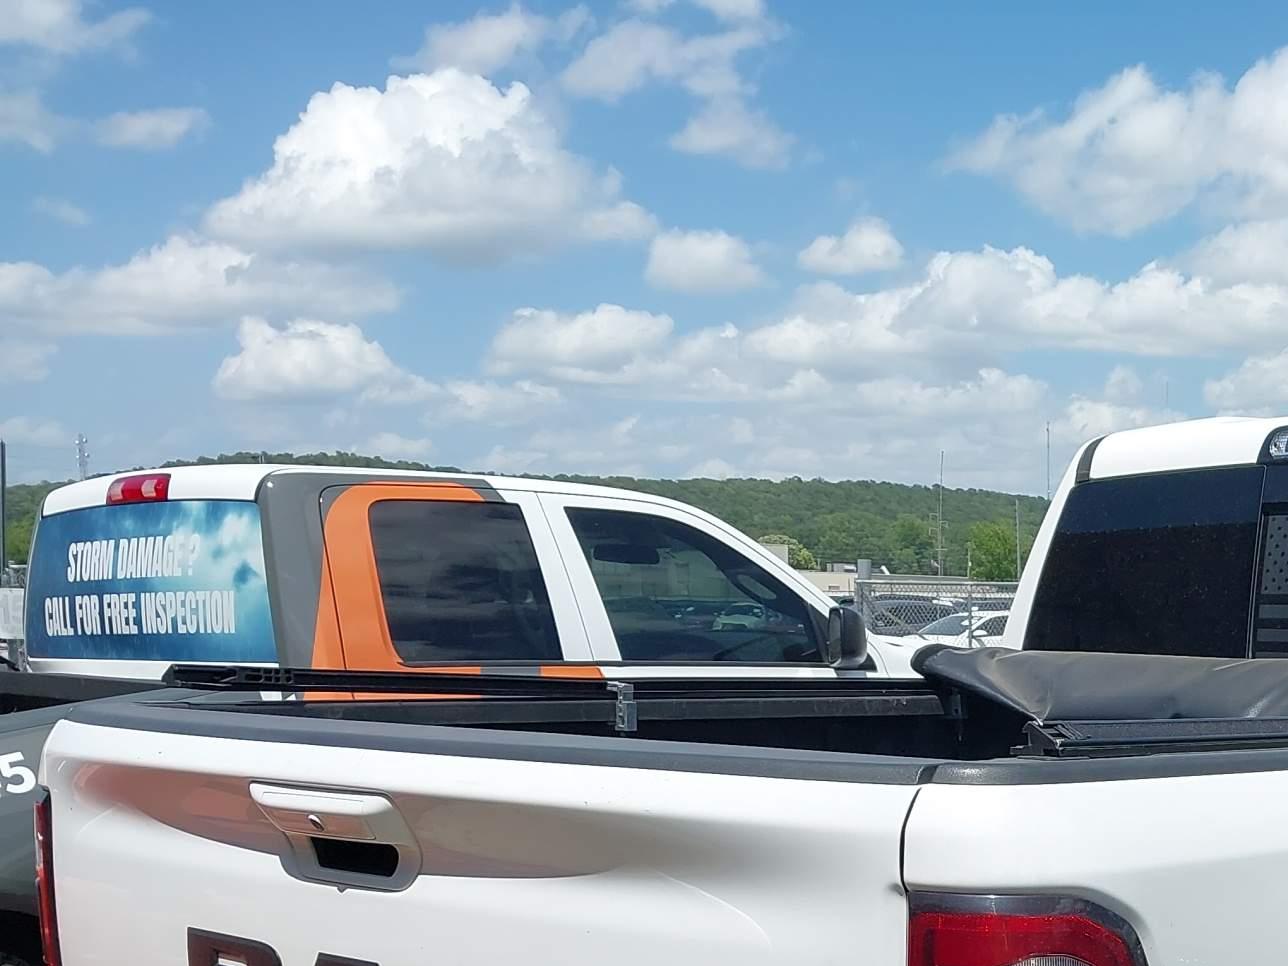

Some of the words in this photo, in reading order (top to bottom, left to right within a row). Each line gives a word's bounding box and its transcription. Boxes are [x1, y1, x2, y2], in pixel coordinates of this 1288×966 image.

[67, 540, 115, 583] STORM
[117, 535, 184, 580] DAMAGE
[44, 596, 74, 637] CALL
[75, 595, 102, 636] FOR
[103, 592, 138, 636] FREE
[140, 589, 237, 635] INSPECTION
